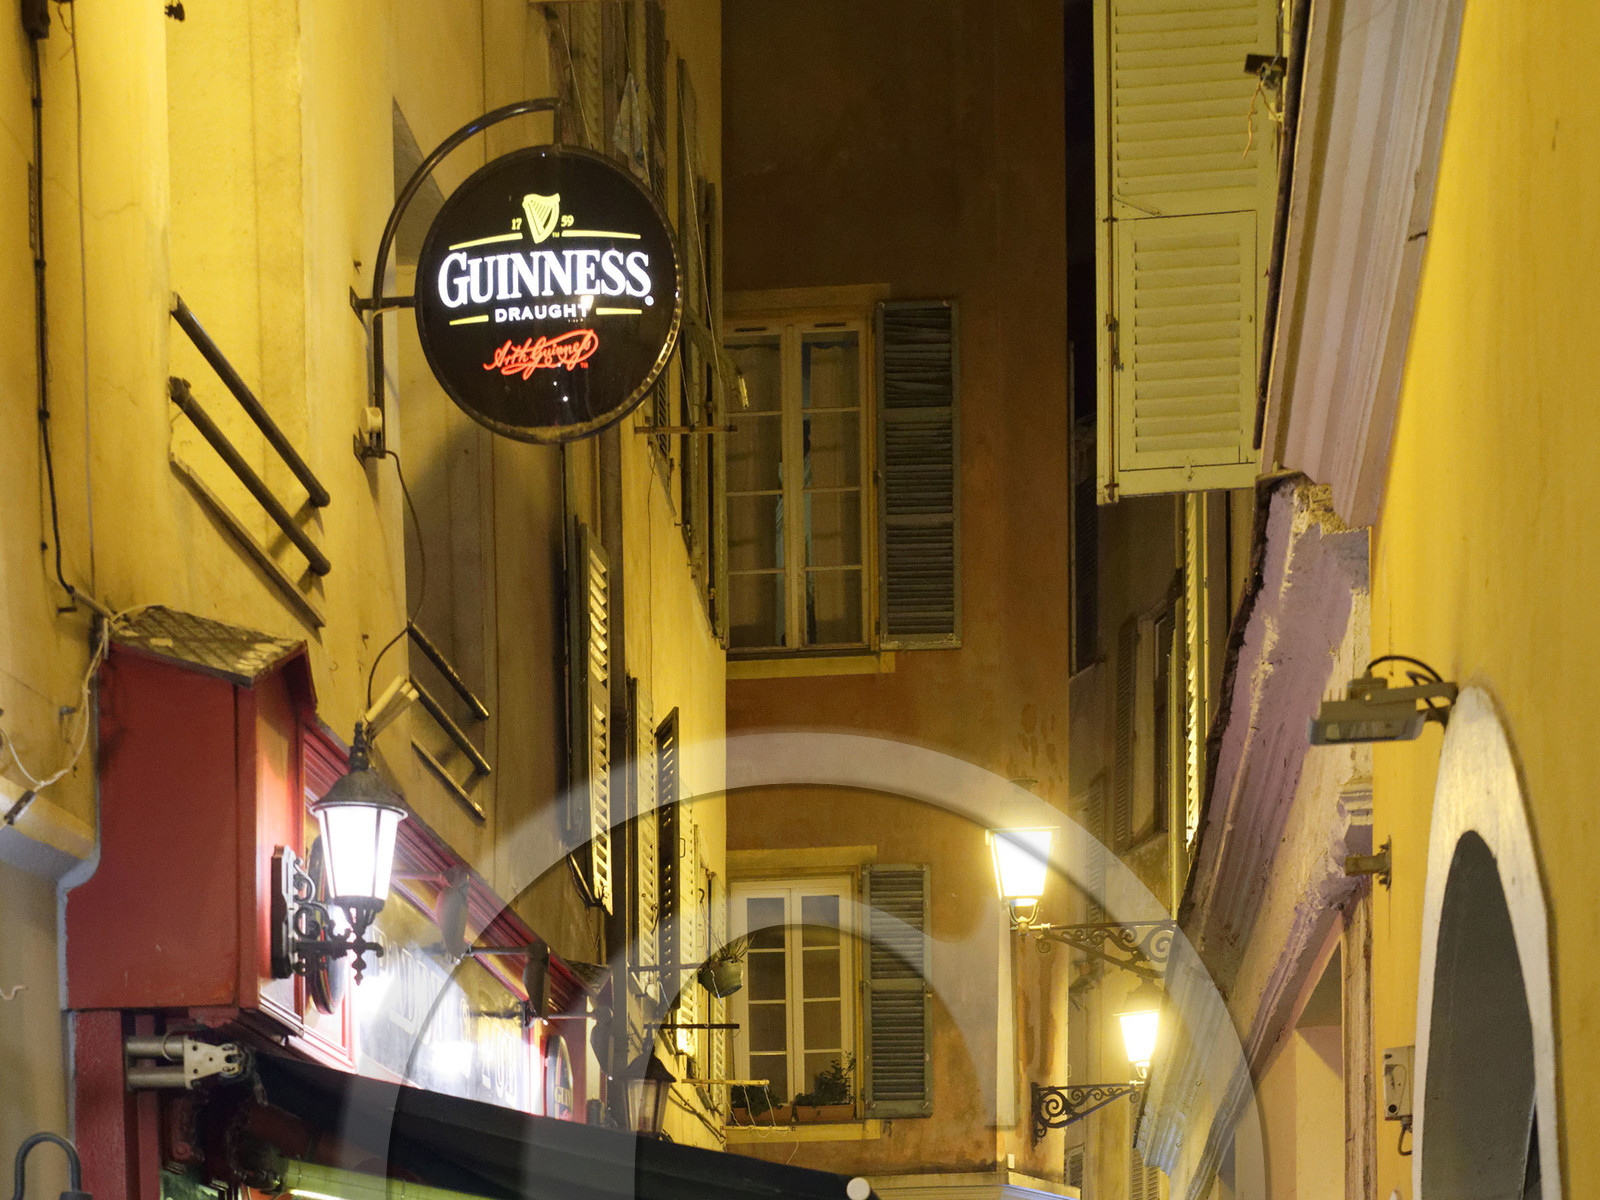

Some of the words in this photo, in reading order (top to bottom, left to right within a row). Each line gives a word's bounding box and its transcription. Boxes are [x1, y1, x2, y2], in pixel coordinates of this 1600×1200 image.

[511, 217, 522, 231] 17
[560, 214, 574, 228] 59
[437, 249, 652, 308] GUINNESS
[494, 303, 588, 323] DRAUGHT
